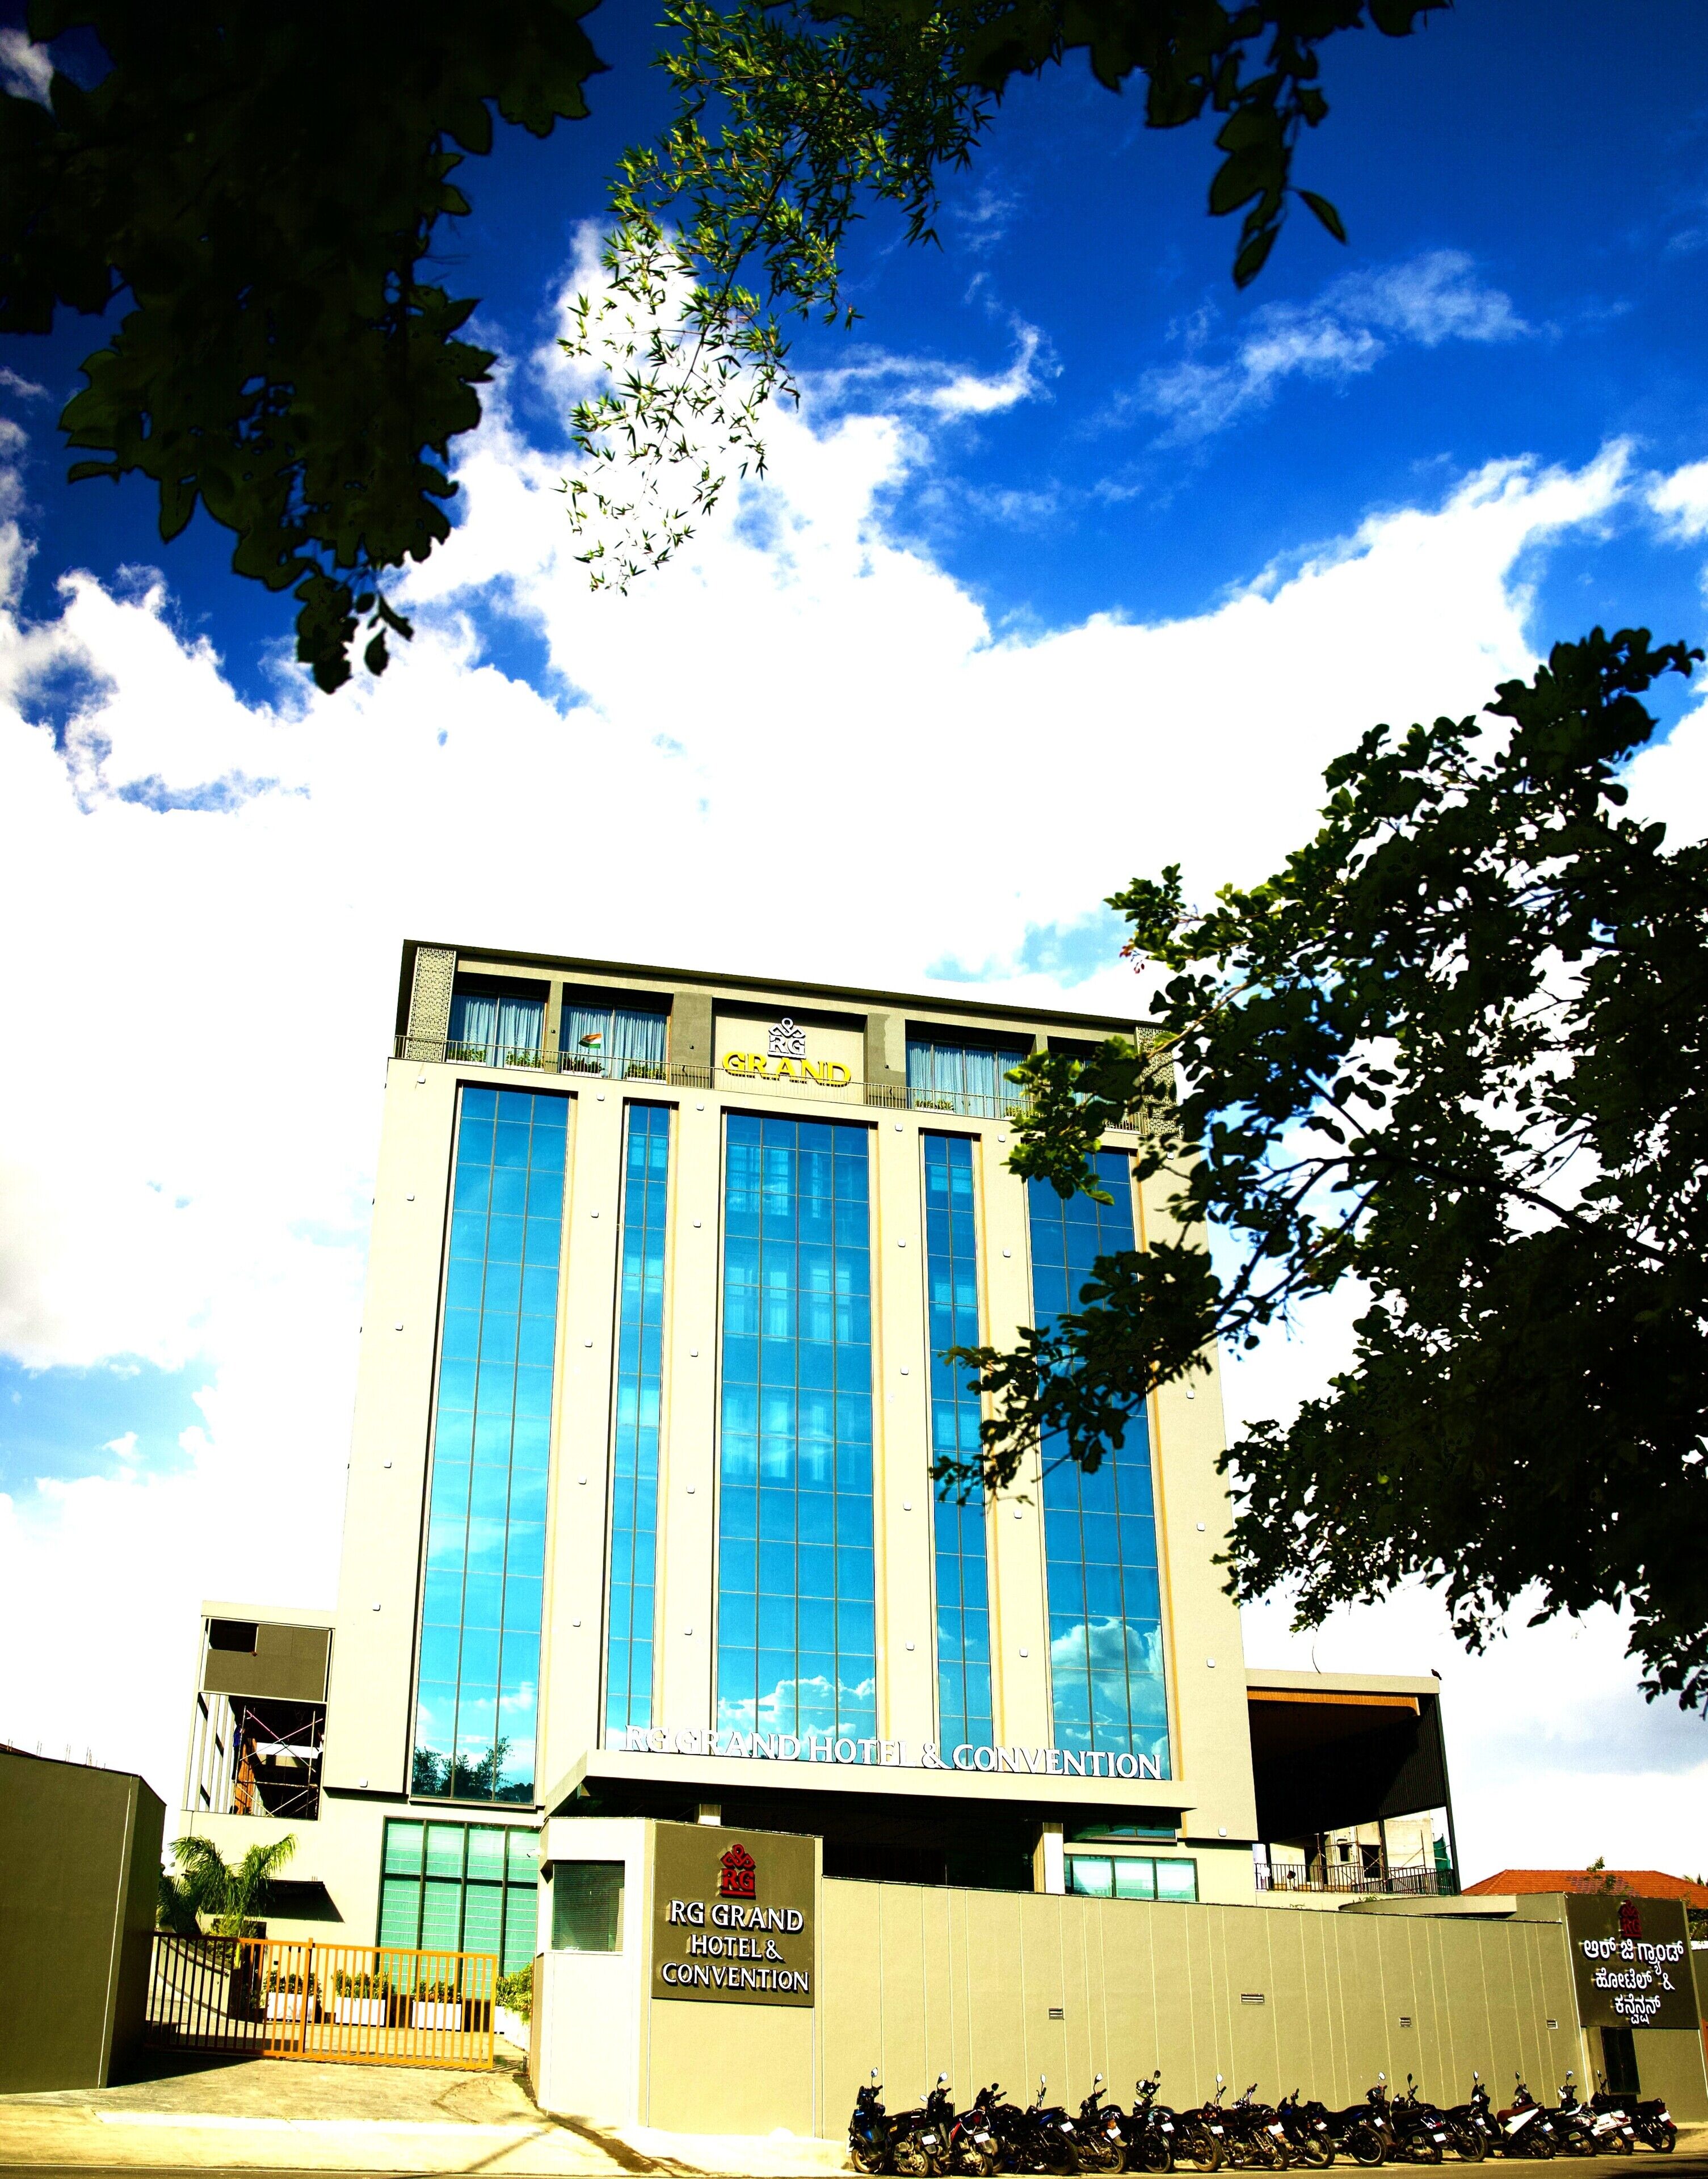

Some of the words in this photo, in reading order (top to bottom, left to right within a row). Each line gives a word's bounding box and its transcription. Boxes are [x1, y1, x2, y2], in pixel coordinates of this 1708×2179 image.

[769, 1035, 805, 1055] RG
[722, 1051, 851, 1087] GRAND
[625, 1724, 670, 1753] RG
[675, 1728, 801, 1760] GRAND
[809, 1735, 918, 1768] HOTEL
[922, 1741, 953, 1769] &
[953, 1744, 1162, 1780] CONVENTION
[721, 1867, 756, 1891] RG
[671, 1900, 705, 1924] RG
[712, 1904, 803, 1932] GRAND
[691, 1933, 762, 1958] HOTEL
[765, 1939, 784, 1961] &
[1584, 1937, 1616, 1958] ಆರ್
[1620, 1938, 1634, 1959] ಜಿ
[662, 1962, 809, 1991] CONVENTION
[1595, 1967, 1652, 1989] ಹೋಟೆಲ್
[1662, 1972, 1675, 1990] &
